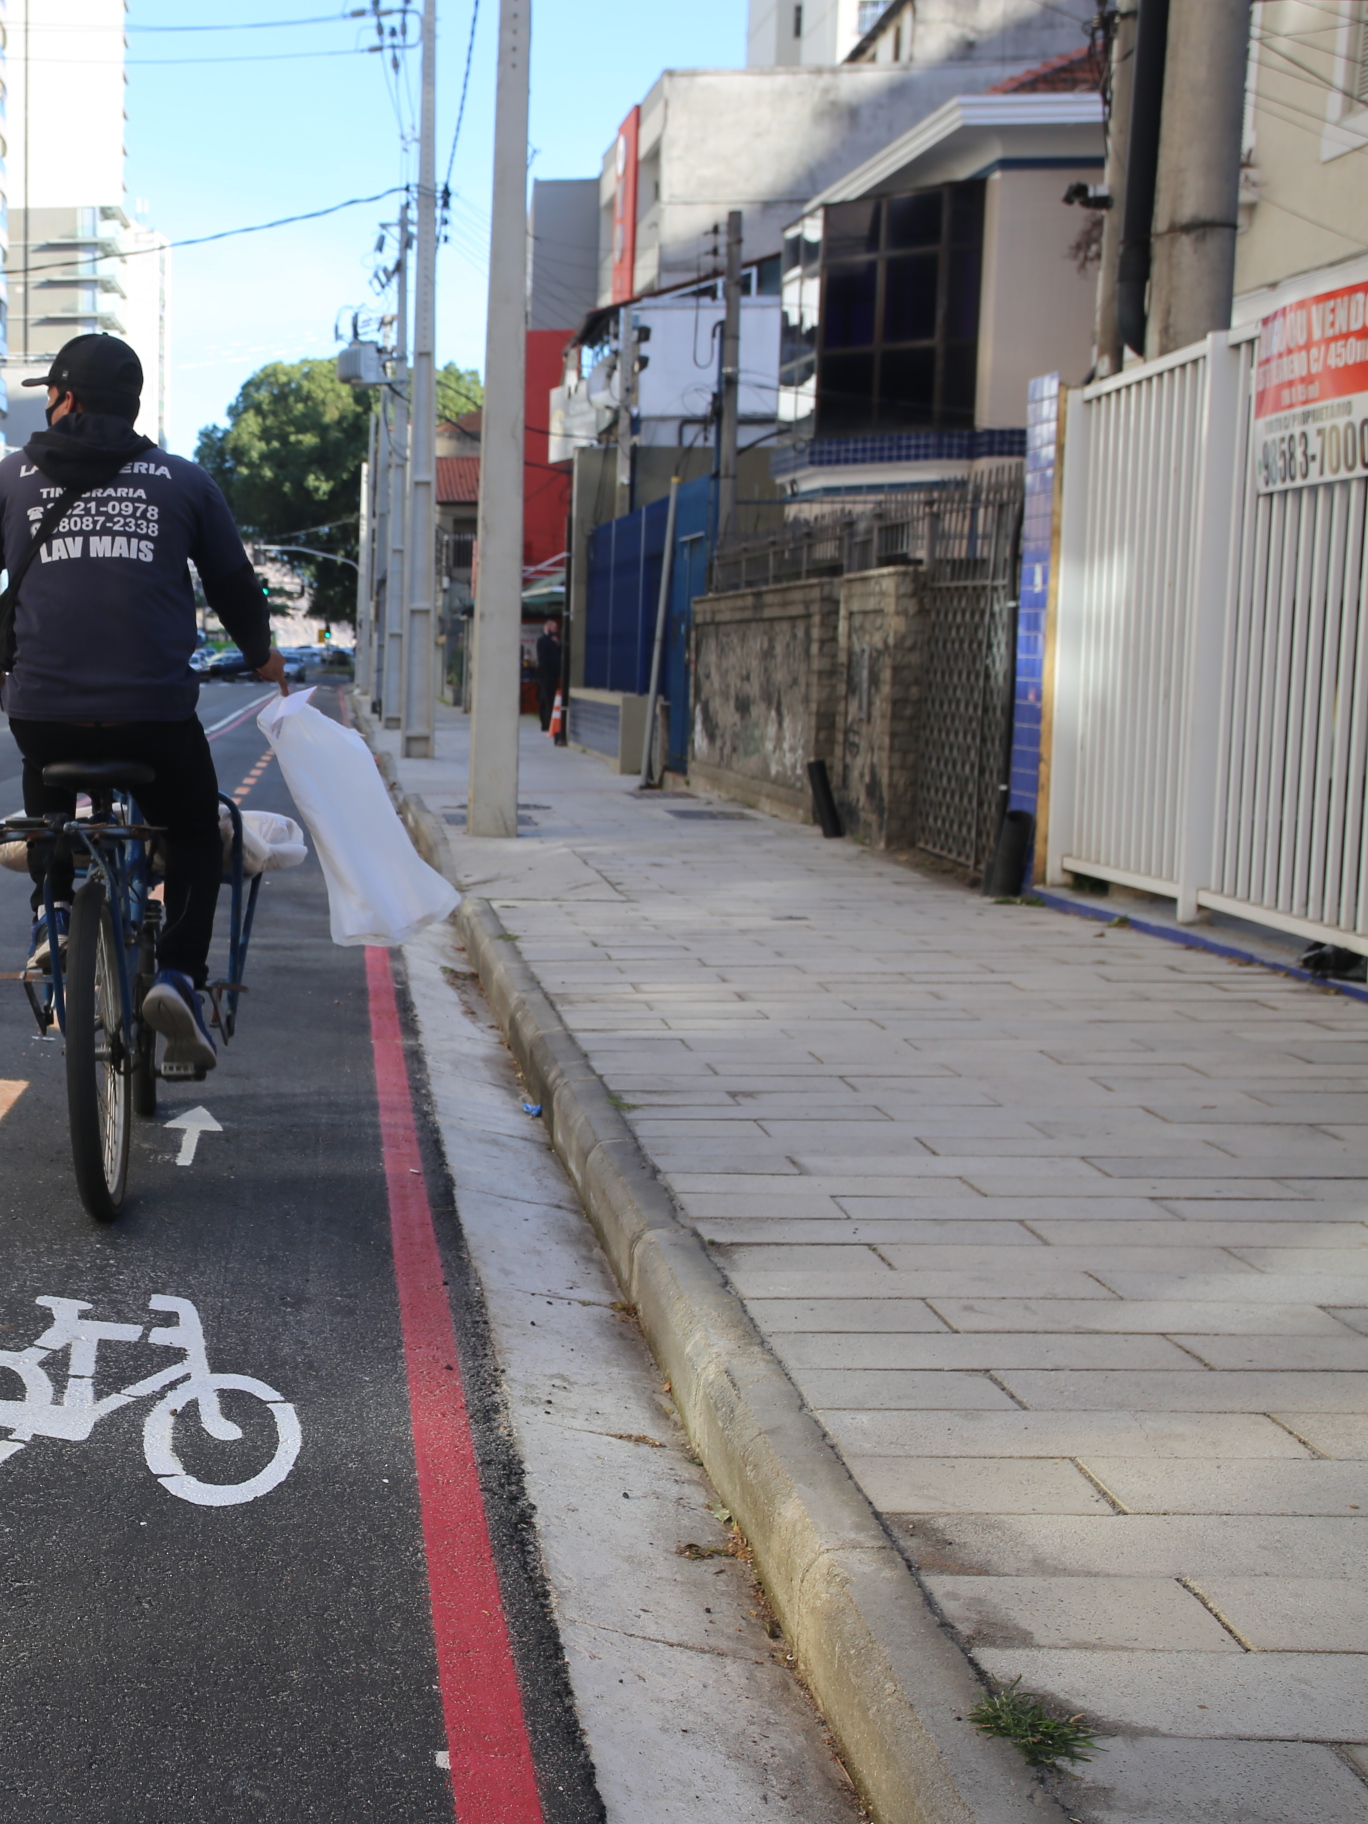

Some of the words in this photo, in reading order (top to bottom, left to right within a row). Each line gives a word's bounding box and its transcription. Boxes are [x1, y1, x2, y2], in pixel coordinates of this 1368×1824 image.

[1311, 293, 1368, 342] VEND
[19, 462, 172, 480] LAERIA
[39, 487, 147, 499] TINRARIA
[46, 501, 159, 520] 21-0978
[51, 516, 159, 537] 8087-2338
[39, 536, 84, 564] LAV
[89, 536, 155, 562] MAIS
